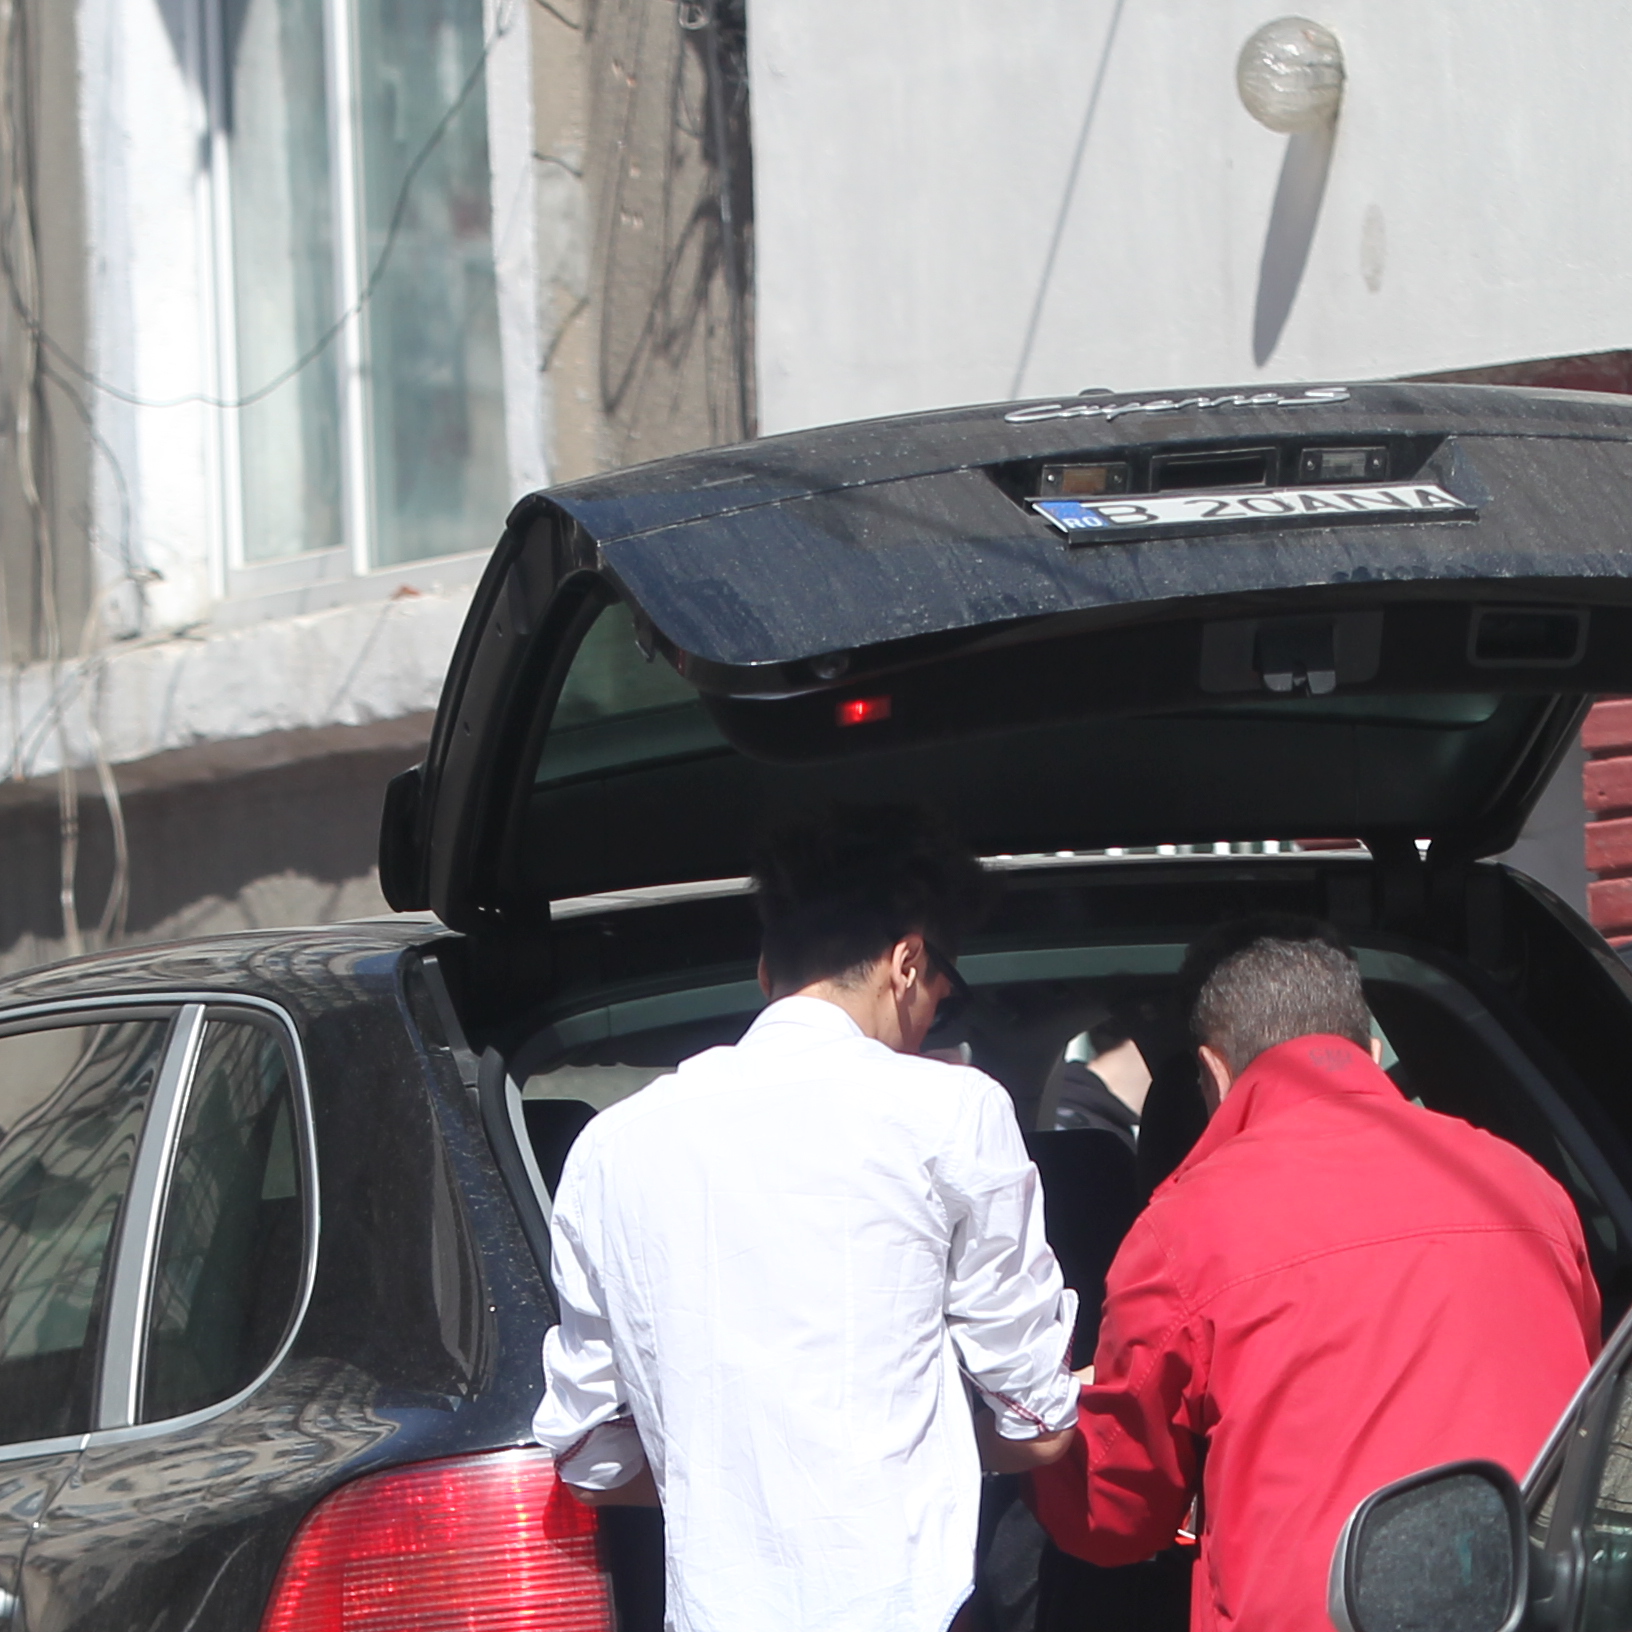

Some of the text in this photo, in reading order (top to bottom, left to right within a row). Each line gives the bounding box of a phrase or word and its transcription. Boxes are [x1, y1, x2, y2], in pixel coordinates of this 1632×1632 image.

[1004, 392, 1282, 422] Cayenne
[1062, 516, 1103, 529] RO
[1088, 504, 1160, 525] B
